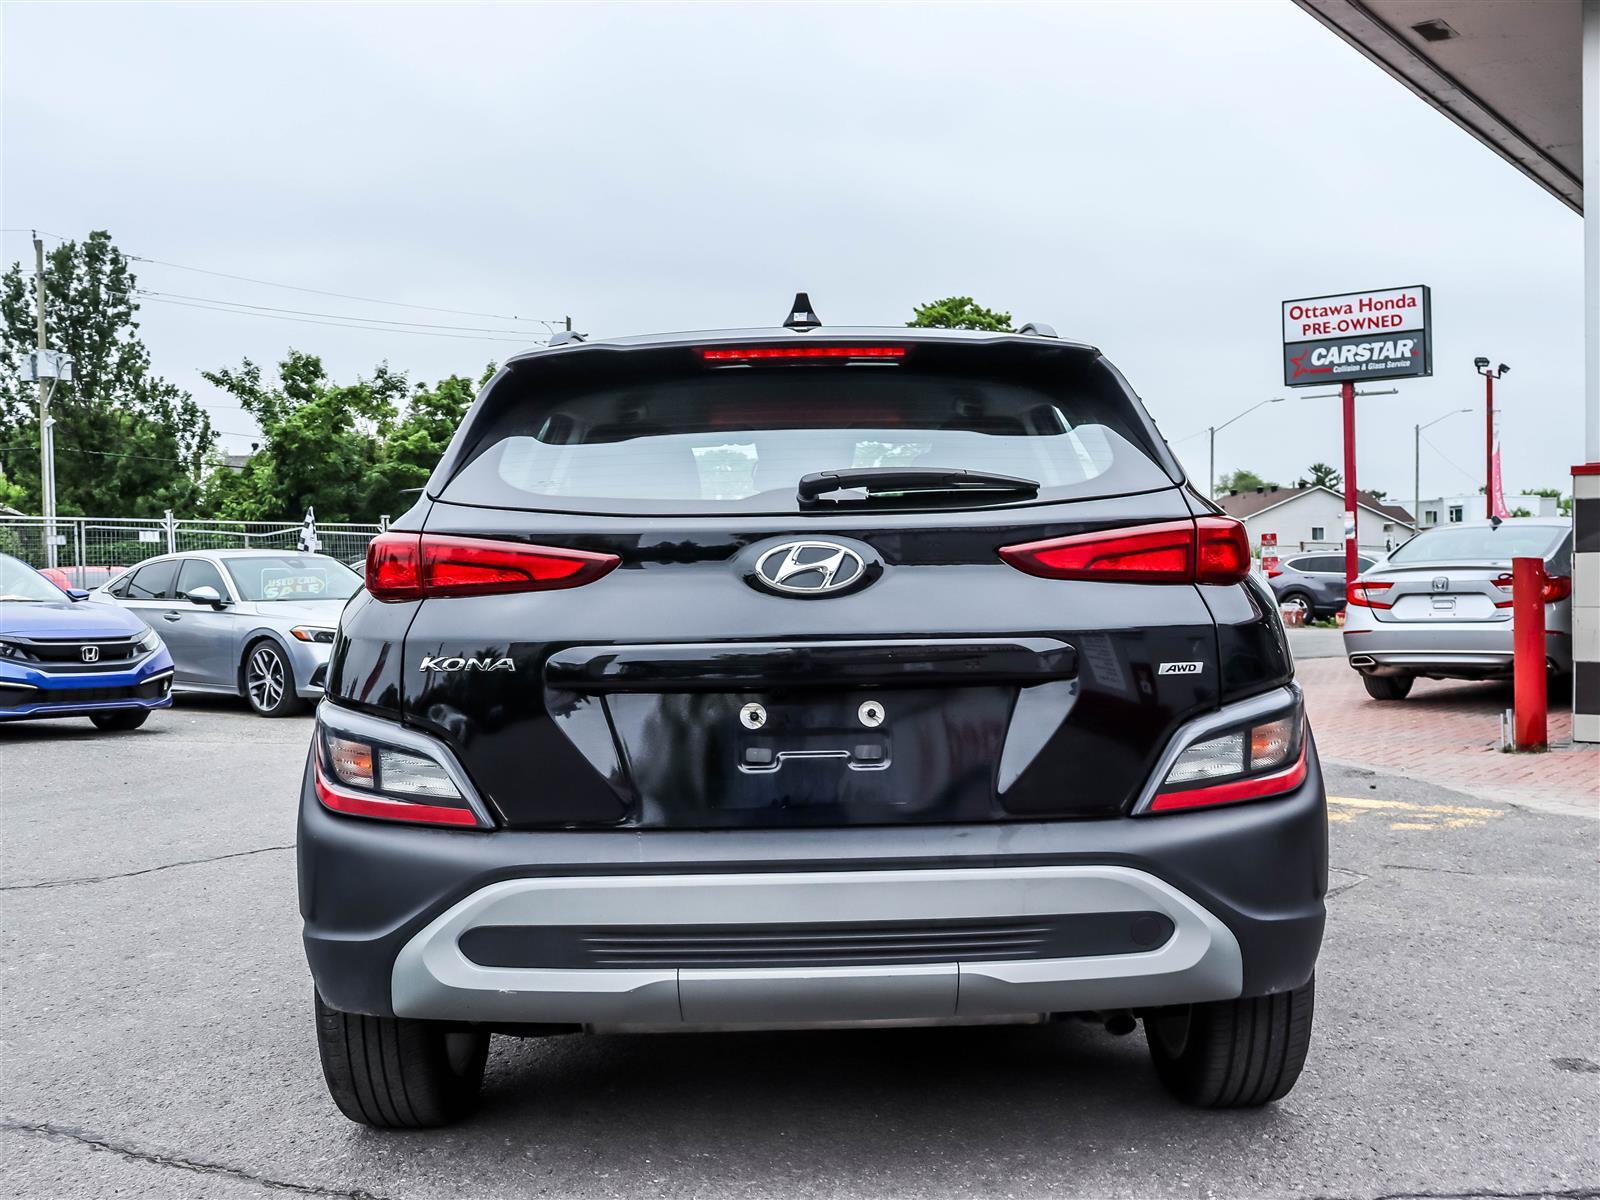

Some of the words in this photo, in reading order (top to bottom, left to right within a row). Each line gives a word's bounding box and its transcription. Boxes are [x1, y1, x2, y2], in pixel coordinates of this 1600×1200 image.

[1289, 303, 1353, 321] Ottawa
[1358, 294, 1417, 313] Honda
[1302, 314, 1403, 336] PRE-OWNED
[1311, 339, 1413, 366] CARSTAR
[1387, 360, 1411, 369] Service
[264, 583, 322, 599] SALE
[419, 656, 516, 672] KONA
[1165, 664, 1197, 672] AWD
